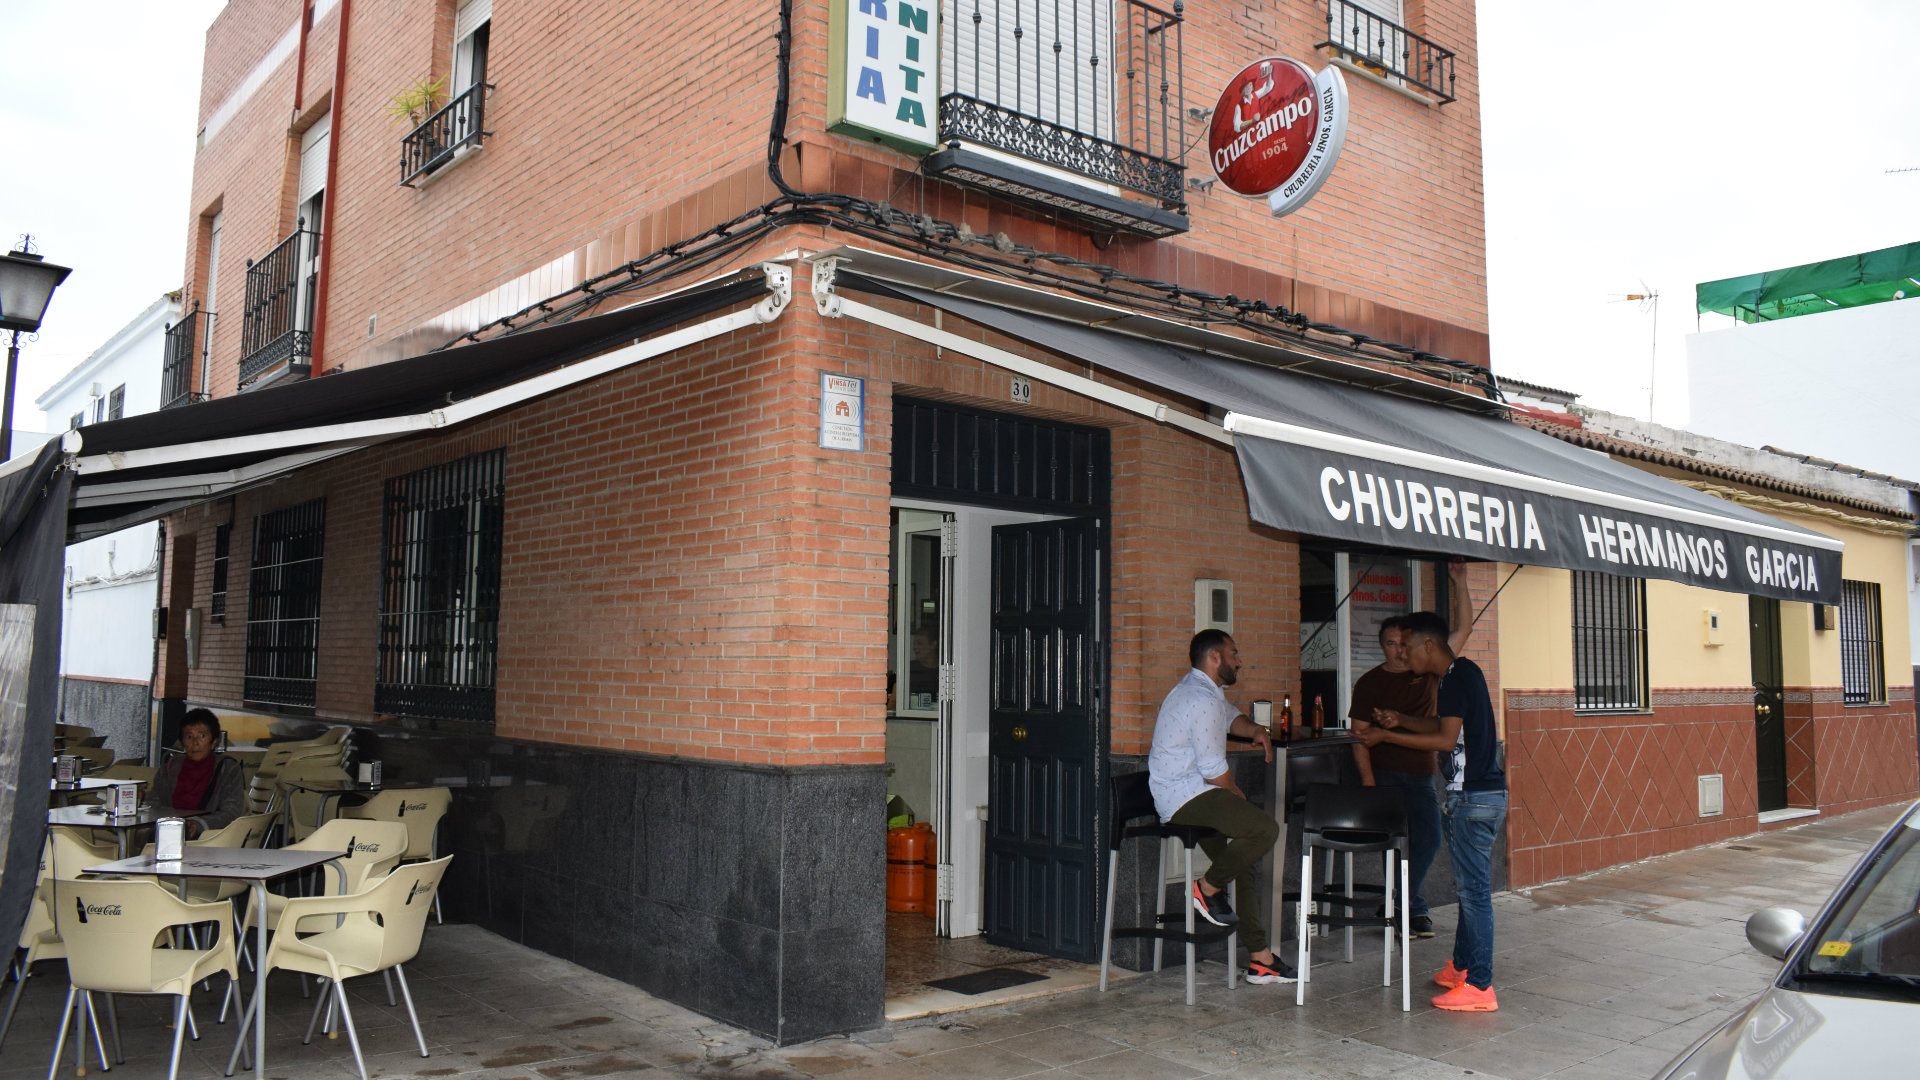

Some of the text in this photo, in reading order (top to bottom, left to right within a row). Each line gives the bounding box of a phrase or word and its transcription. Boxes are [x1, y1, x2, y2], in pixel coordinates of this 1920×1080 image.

[1214, 97, 1312, 174] Cruzcampo
[1261, 142, 1289, 160] 1904
[1283, 86, 1334, 198] CHURRERIA HNOS. GARCIA
[1013, 382, 1030, 398] 30
[1320, 466, 1819, 592] CHURRERIA HERMANOS GARCIA
[87, 904, 123, 917] Coca-Cola
